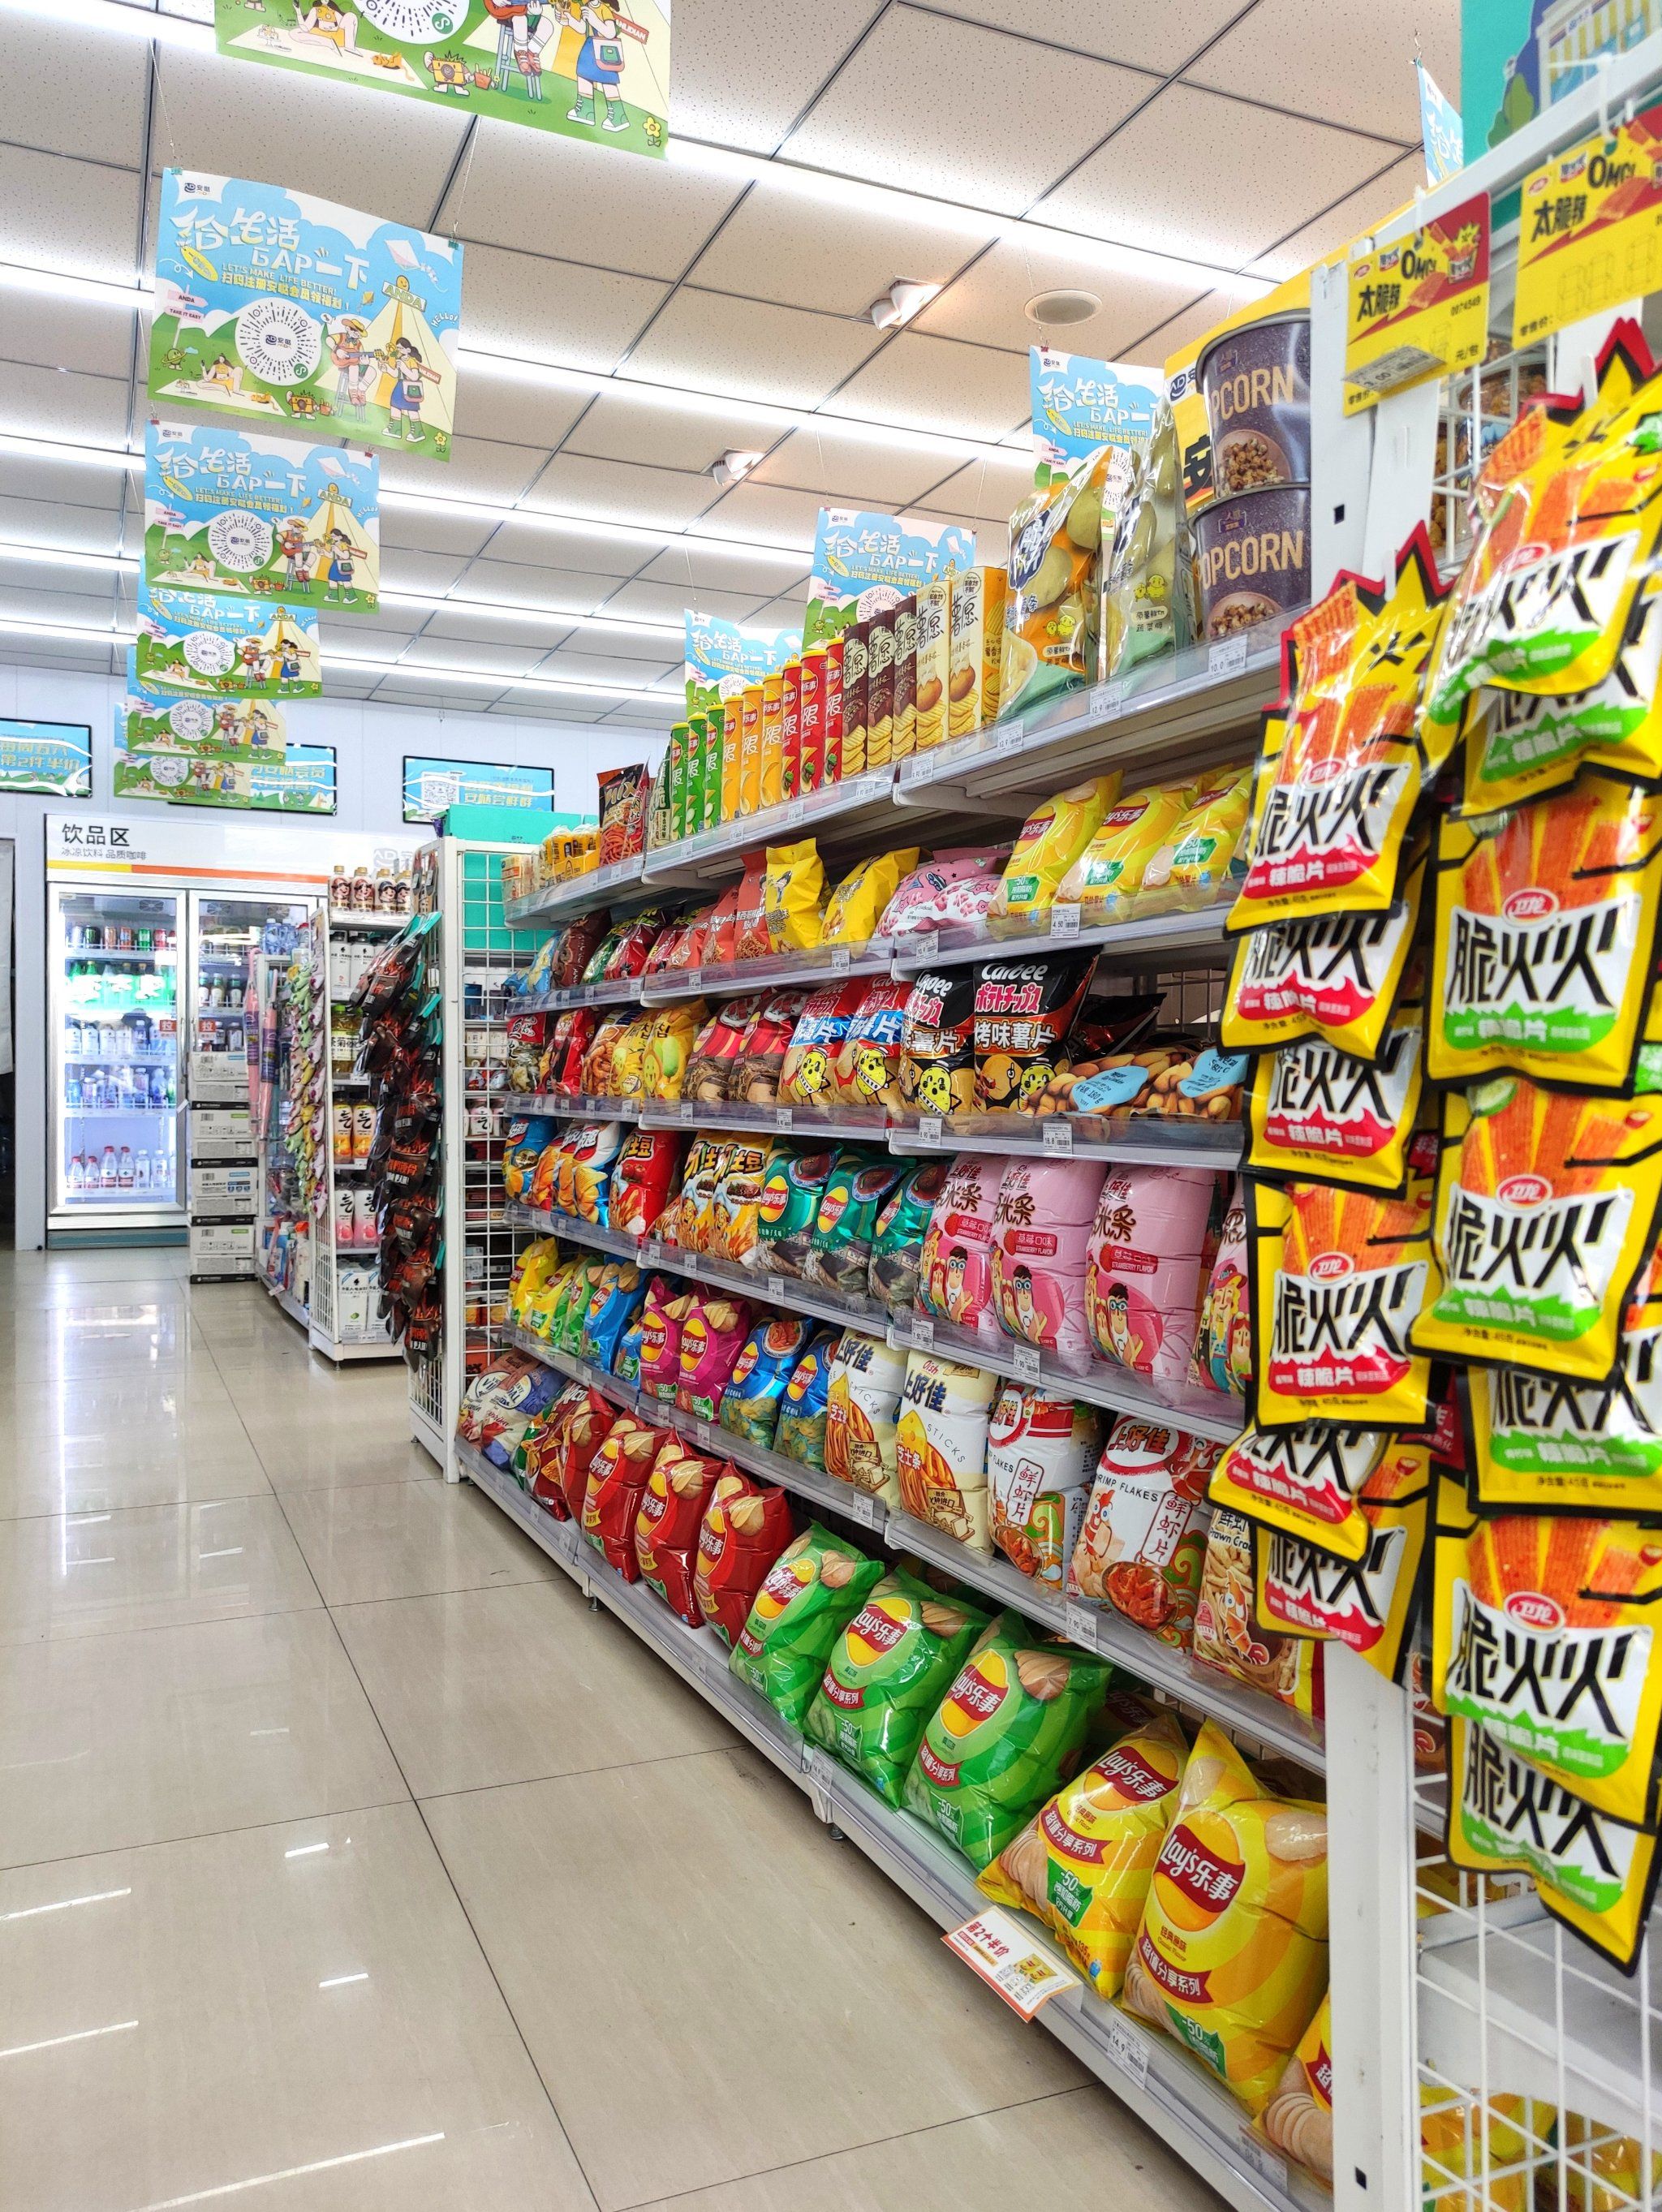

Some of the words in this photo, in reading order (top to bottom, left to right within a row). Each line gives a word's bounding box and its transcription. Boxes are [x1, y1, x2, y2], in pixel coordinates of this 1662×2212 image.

[222, 263, 248, 274] LET'S
[249, 268, 274, 279] MAKE
[280, 274, 298, 284] LIFE
[301, 280, 336, 295] BETTER!
[179, 295, 195, 303] ANDA
[385, 285, 422, 309] ANDA
[190, 312, 201, 320] EASY
[431, 312, 459, 327] HELLO!
[320, 490, 350, 506] ANDA
[62, 824, 130, 846] 饮品区
[980, 962, 1048, 982] Calbee
[974, 1022, 1056, 1048] 烤味薯片
[1018, 1233, 1053, 1246] 草莓口味
[1137, 1265, 1154, 1274] FLAVOR
[830, 1403, 847, 1425] 芝士
[927, 1423, 966, 1463] STICKS
[1108, 1425, 1170, 1455] 上好佳
[897, 1446, 922, 1470] 芝士条
[1011, 1464, 1038, 1523] 鲜虾片
[1096, 1474, 1117, 1486] RIMP
[1120, 1483, 1158, 1502] FLAKES
[1149, 1495, 1186, 1564] 鲜虾片
[1045, 1809, 1098, 1857] 超值分享系列
[966, 1922, 1010, 1957] 第2个半价
[1143, 1937, 1202, 1996] 超值分享系列
[1112, 2034, 1126, 2053] 14.9
